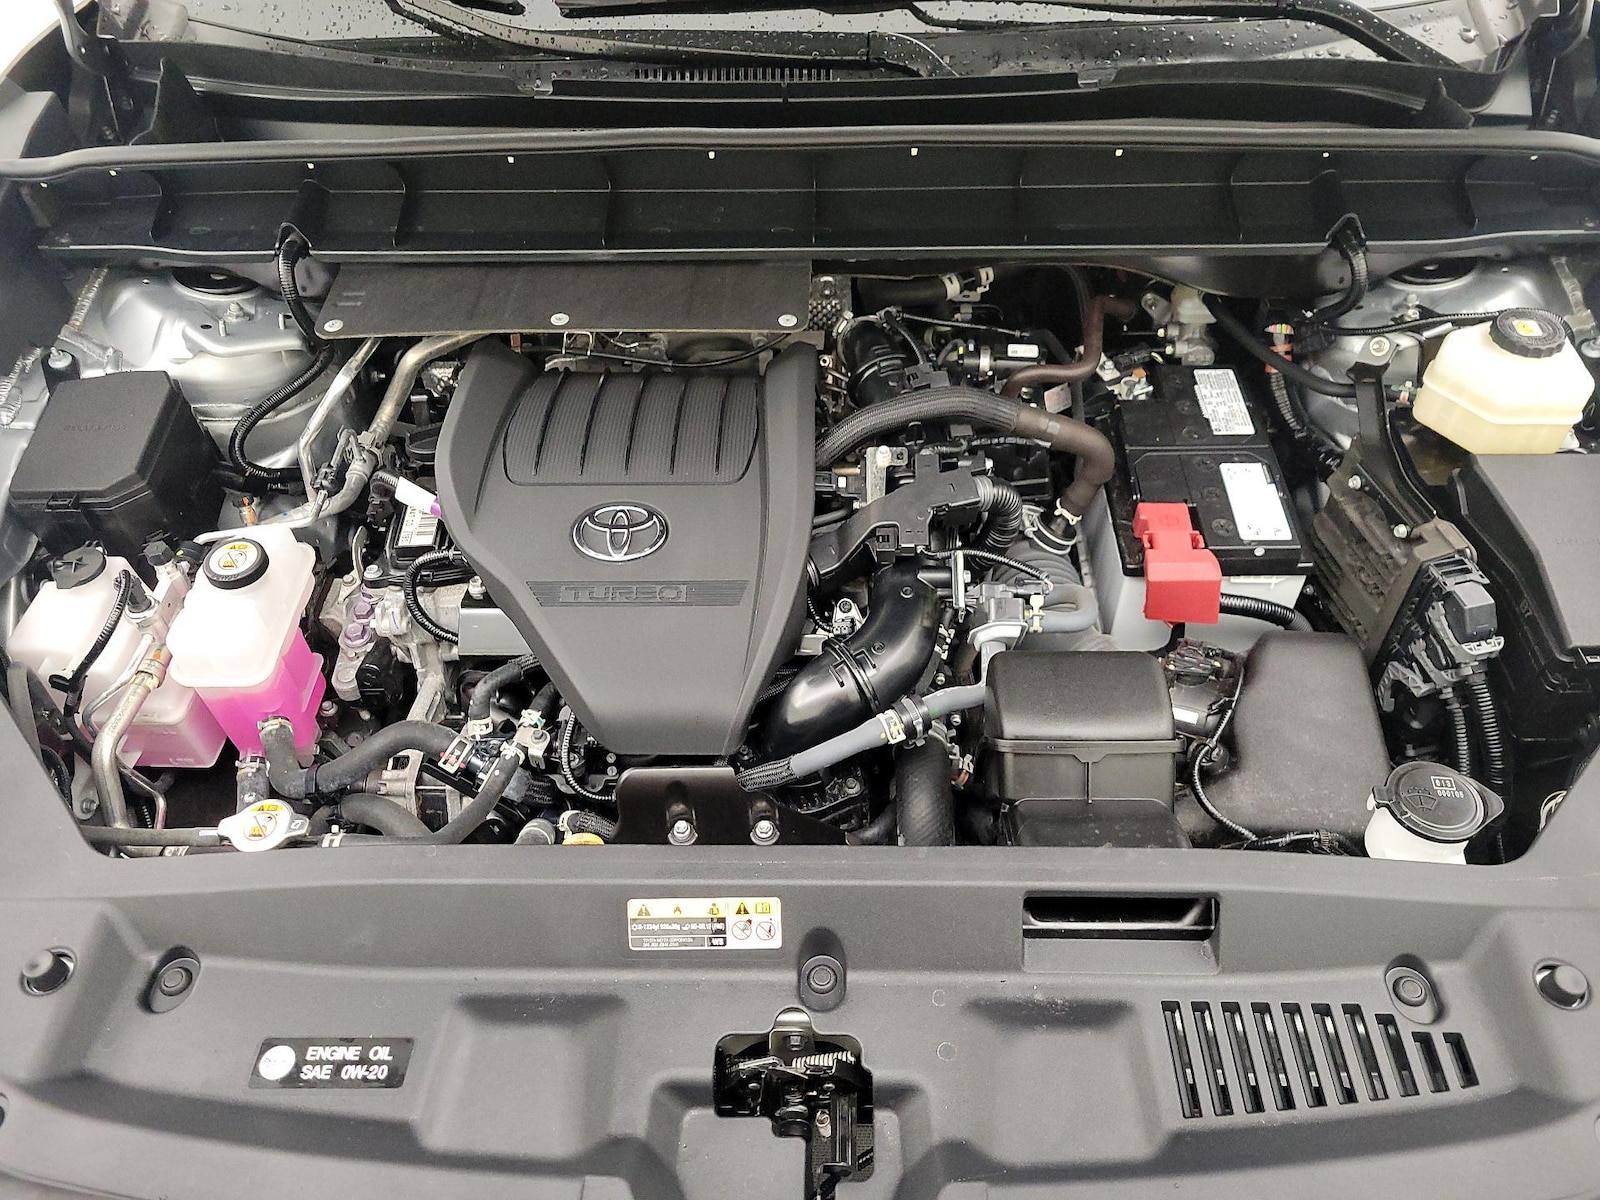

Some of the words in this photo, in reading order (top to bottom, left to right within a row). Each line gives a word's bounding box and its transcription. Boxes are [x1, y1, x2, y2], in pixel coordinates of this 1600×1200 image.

[564, 585, 685, 601] TURBO
[305, 1046, 362, 1061] ENGINE
[368, 1046, 393, 1061] OIL
[300, 1065, 333, 1079] SAE
[341, 1065, 388, 1080] 0W-20
